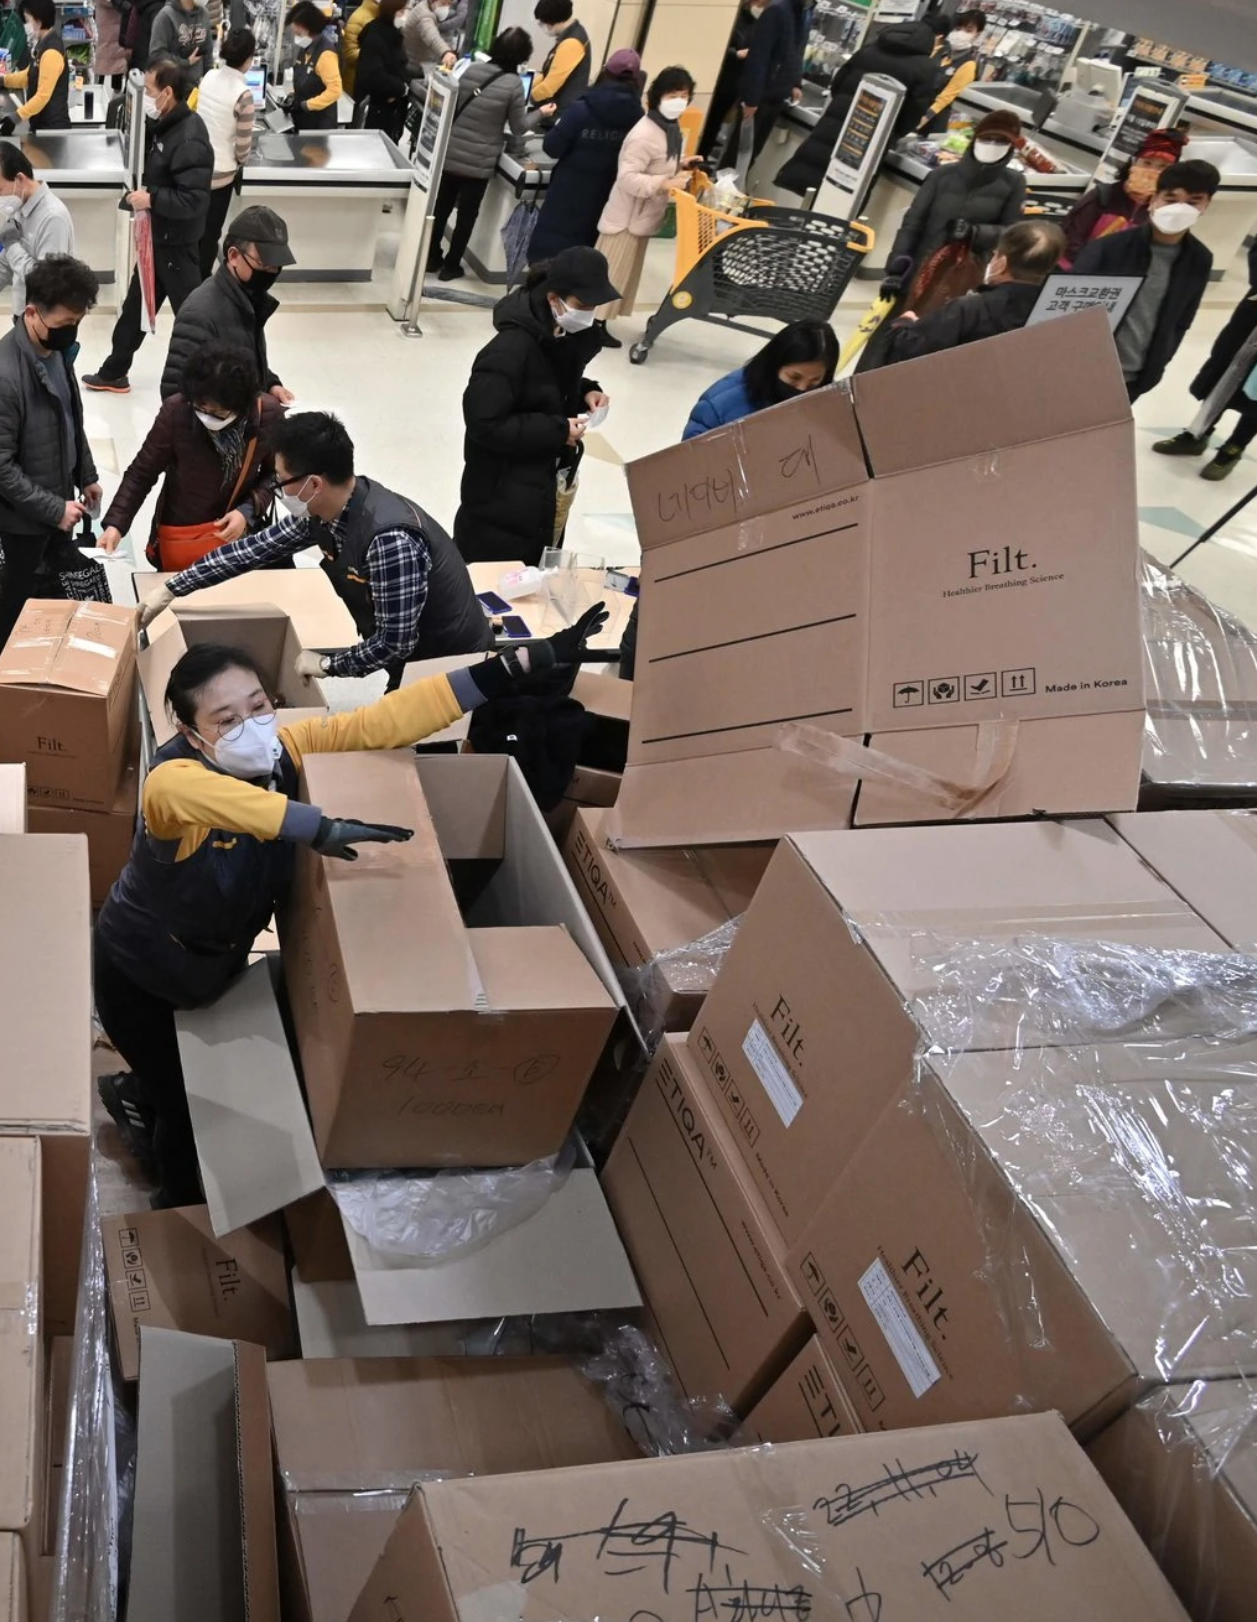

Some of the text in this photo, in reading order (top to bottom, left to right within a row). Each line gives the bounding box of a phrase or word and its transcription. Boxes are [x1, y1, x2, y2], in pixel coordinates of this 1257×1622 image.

[1045, 299, 1071, 312] 고객
[1054, 286, 1123, 301] 마스크교환권
[791, 495, 861, 521] www.etiqa.co.kr
[967, 545, 1038, 580] Filt.
[942, 572, 1065, 598] Healthier Breathing Science
[1045, 678, 1128, 694] Made in Korea
[770, 993, 804, 1068] Filt.
[215, 1258, 242, 1302] Filt.
[901, 1245, 949, 1341] Filt.
